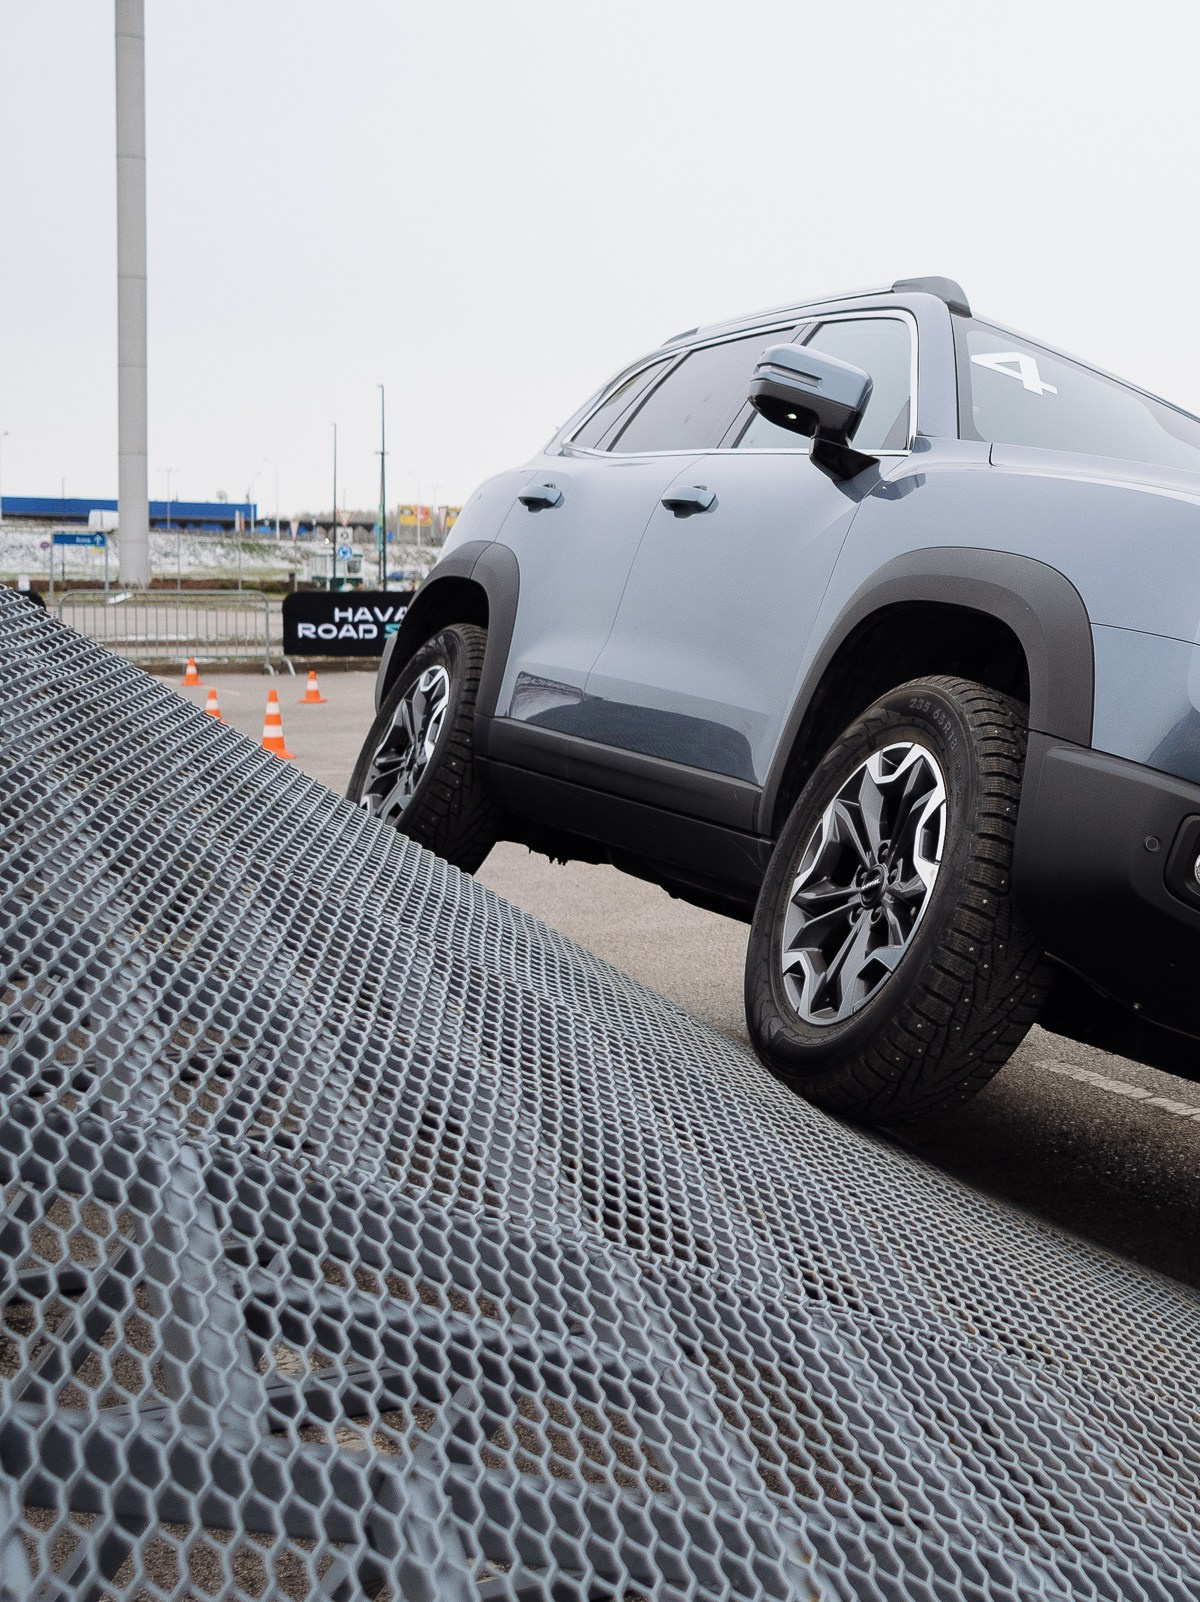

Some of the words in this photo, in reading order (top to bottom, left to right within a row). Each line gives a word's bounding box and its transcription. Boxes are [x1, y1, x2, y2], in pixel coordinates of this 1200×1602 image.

[971, 352, 1058, 395] 4
[334, 606, 408, 623] HAVA
[297, 622, 378, 639] ROAD
